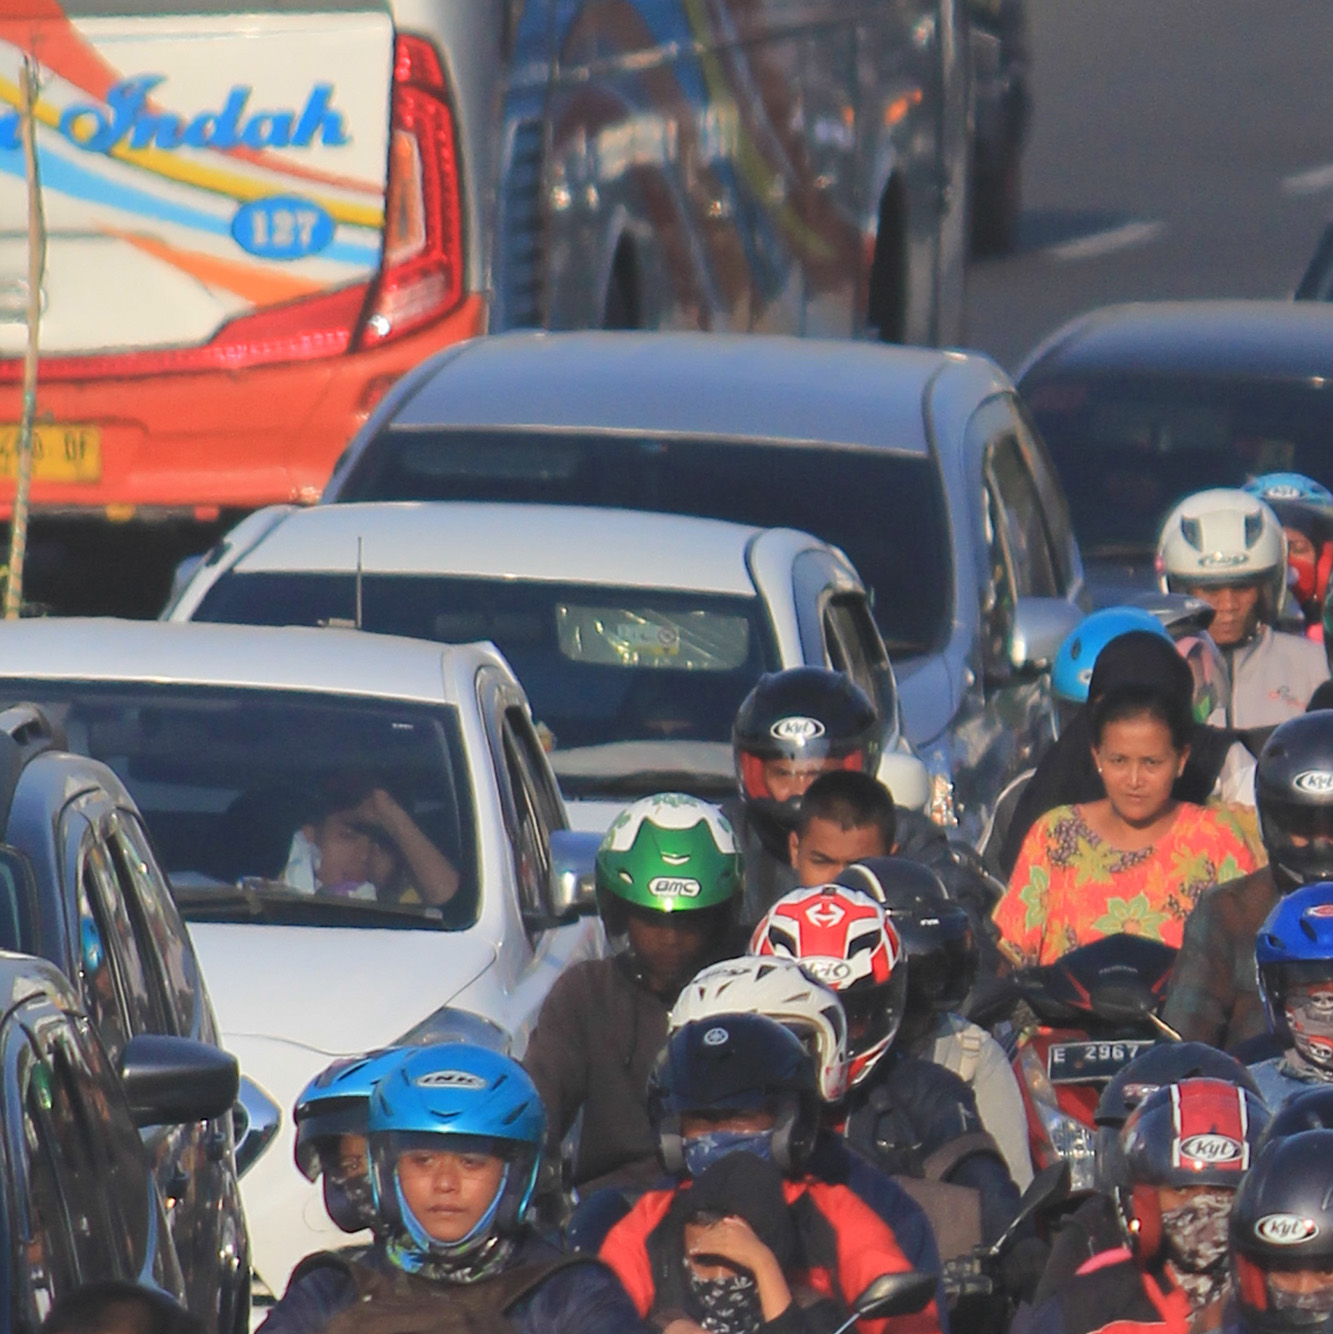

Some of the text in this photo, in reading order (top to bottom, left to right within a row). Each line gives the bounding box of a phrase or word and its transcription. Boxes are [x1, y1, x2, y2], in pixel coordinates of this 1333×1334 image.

[59, 74, 354, 156] Indah
[252, 208, 319, 248] 127
[654, 880, 697, 894] BMC
[1053, 1044, 1140, 1064] E 2967
[423, 1073, 478, 1086] INK
